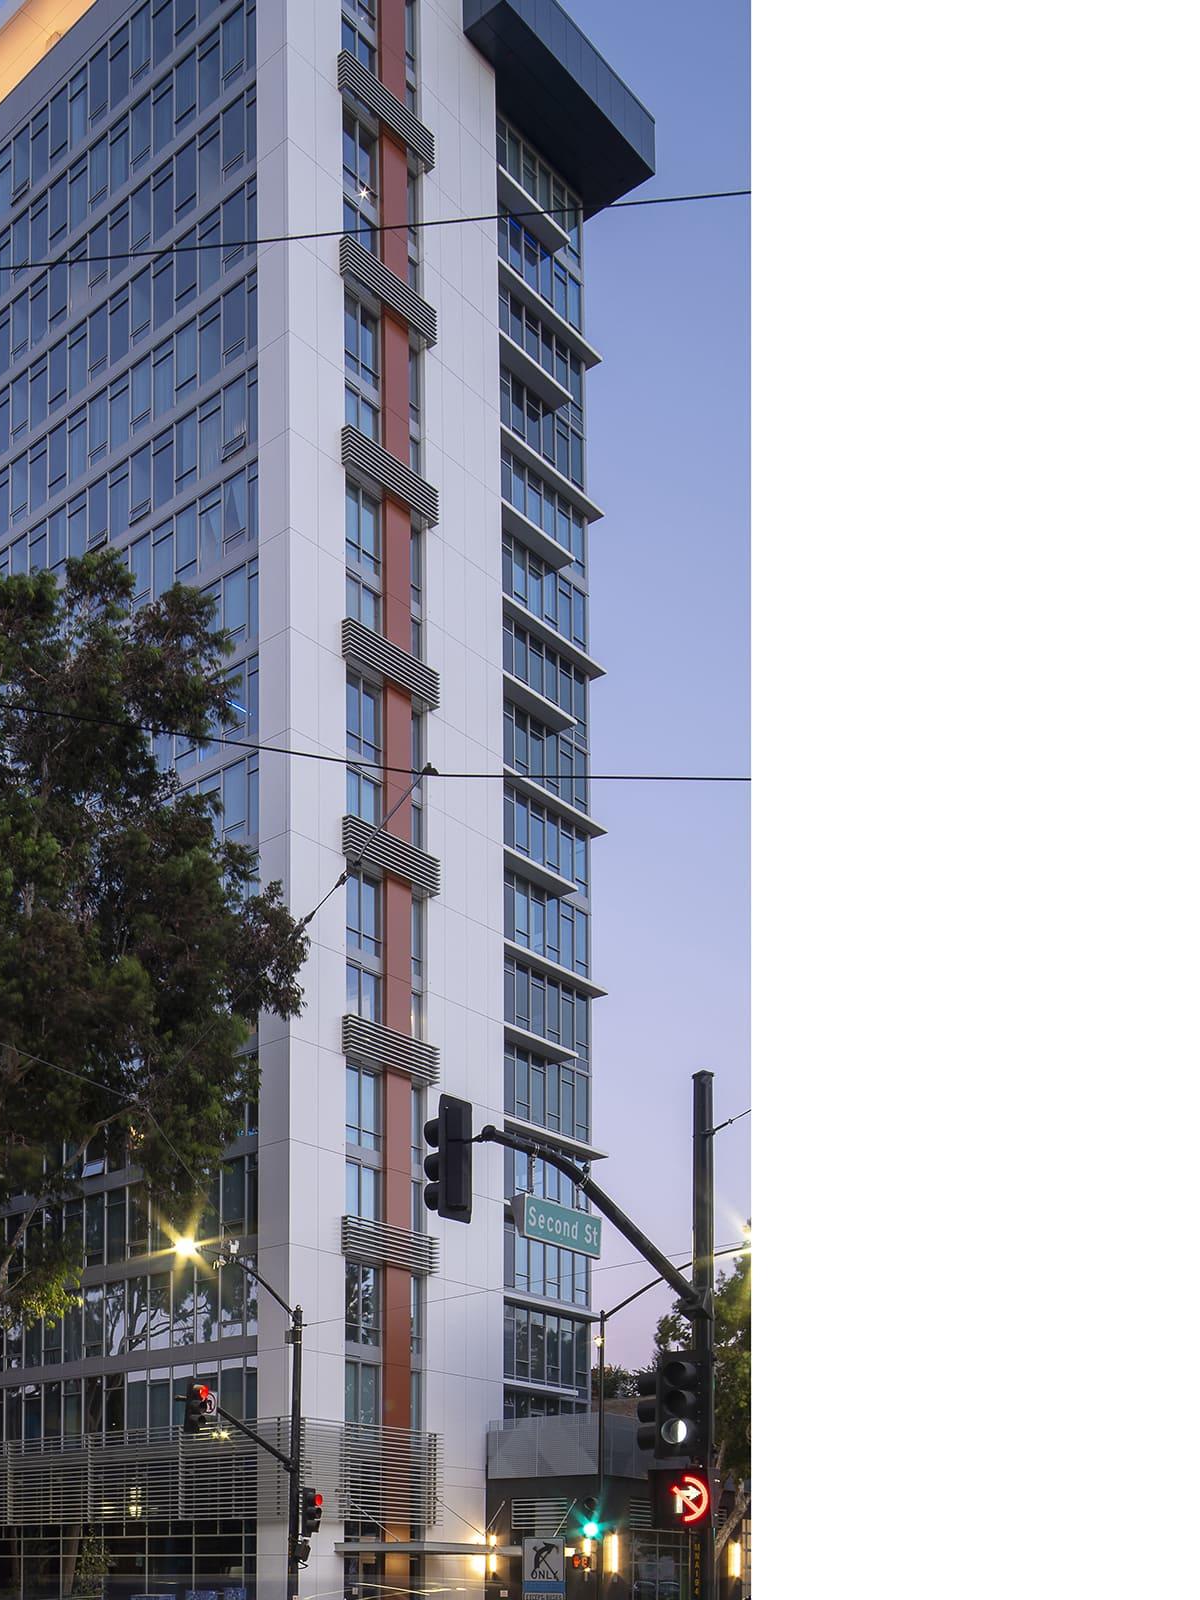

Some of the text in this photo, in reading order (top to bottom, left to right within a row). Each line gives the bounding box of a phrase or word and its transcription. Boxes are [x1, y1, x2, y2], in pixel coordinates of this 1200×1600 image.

[528, 1206, 598, 1247] Second St
[531, 1570, 559, 1580] ONLY
